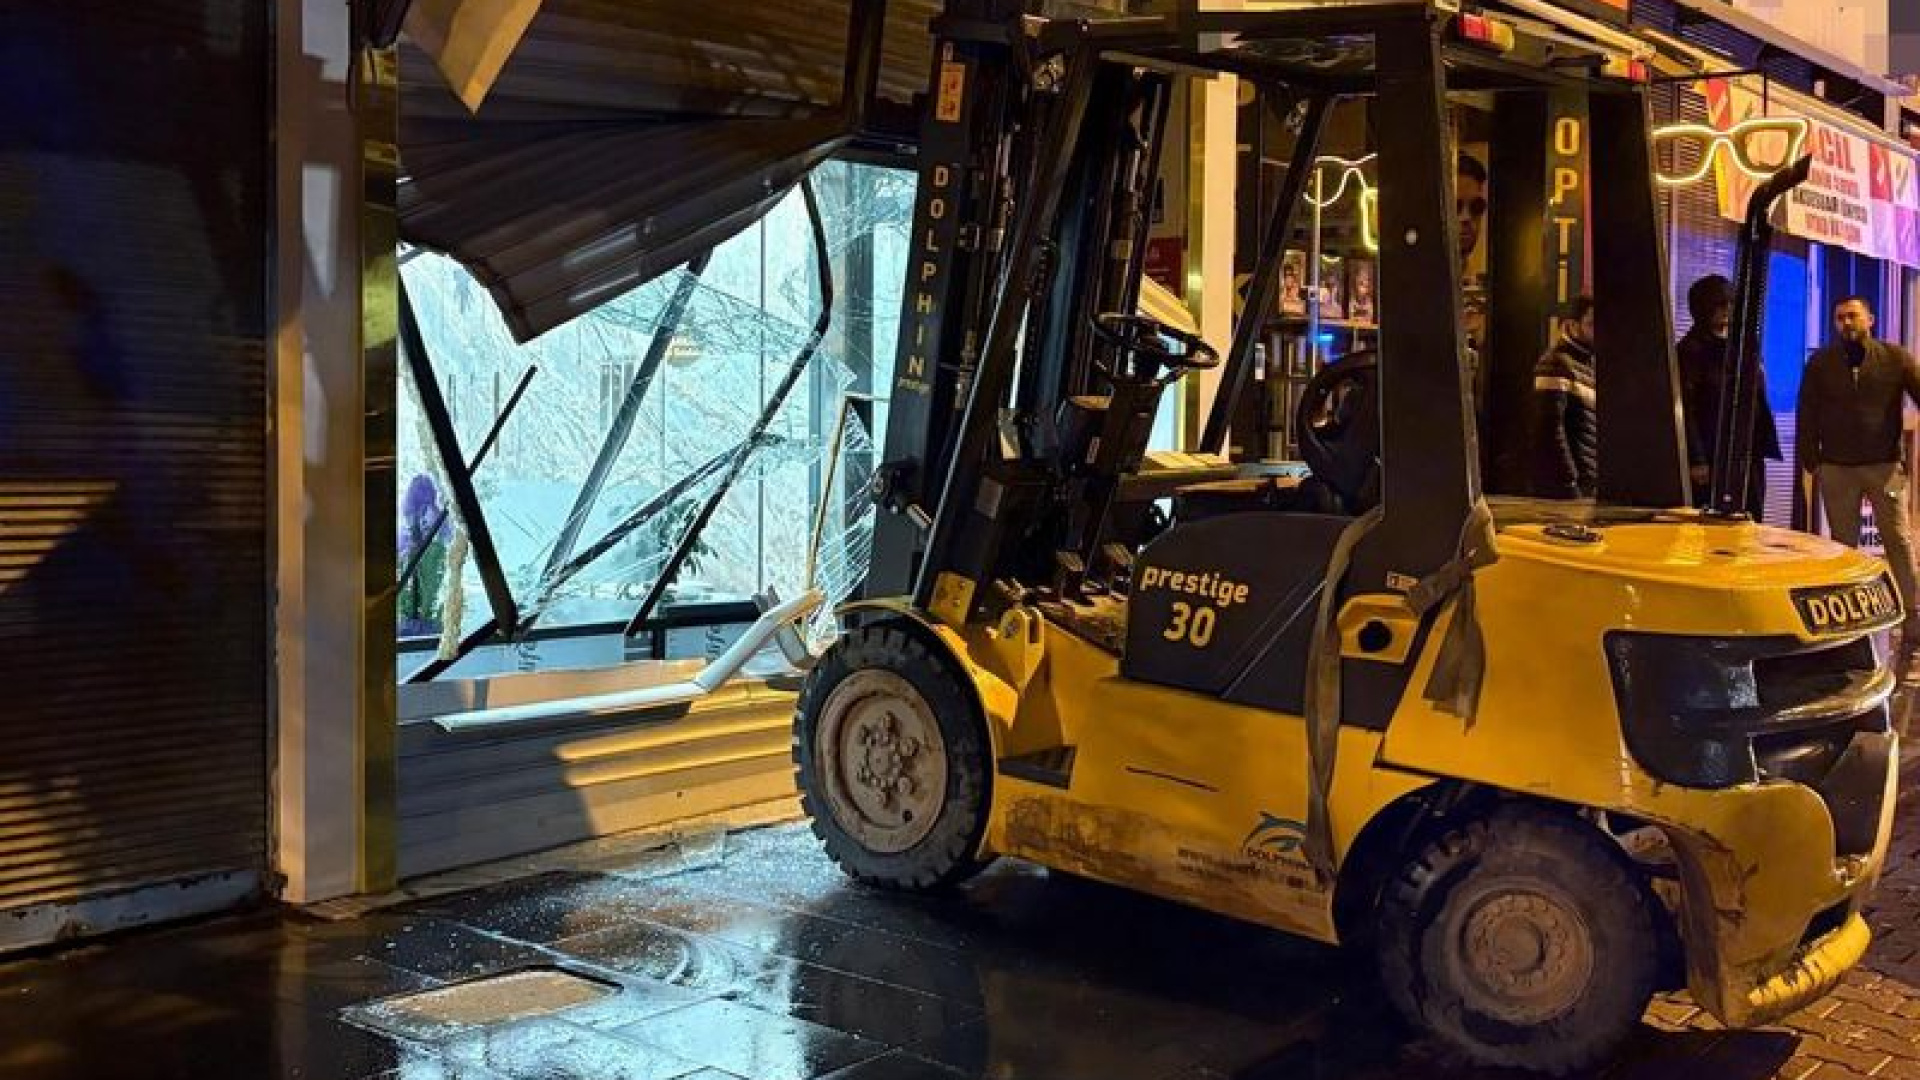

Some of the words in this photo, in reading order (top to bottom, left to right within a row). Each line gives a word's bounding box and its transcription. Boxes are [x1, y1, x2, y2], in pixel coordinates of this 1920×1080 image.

[908, 164, 949, 377] DOLPHIN
[1139, 565, 1249, 608] prestige
[1163, 601, 1216, 648] 30
